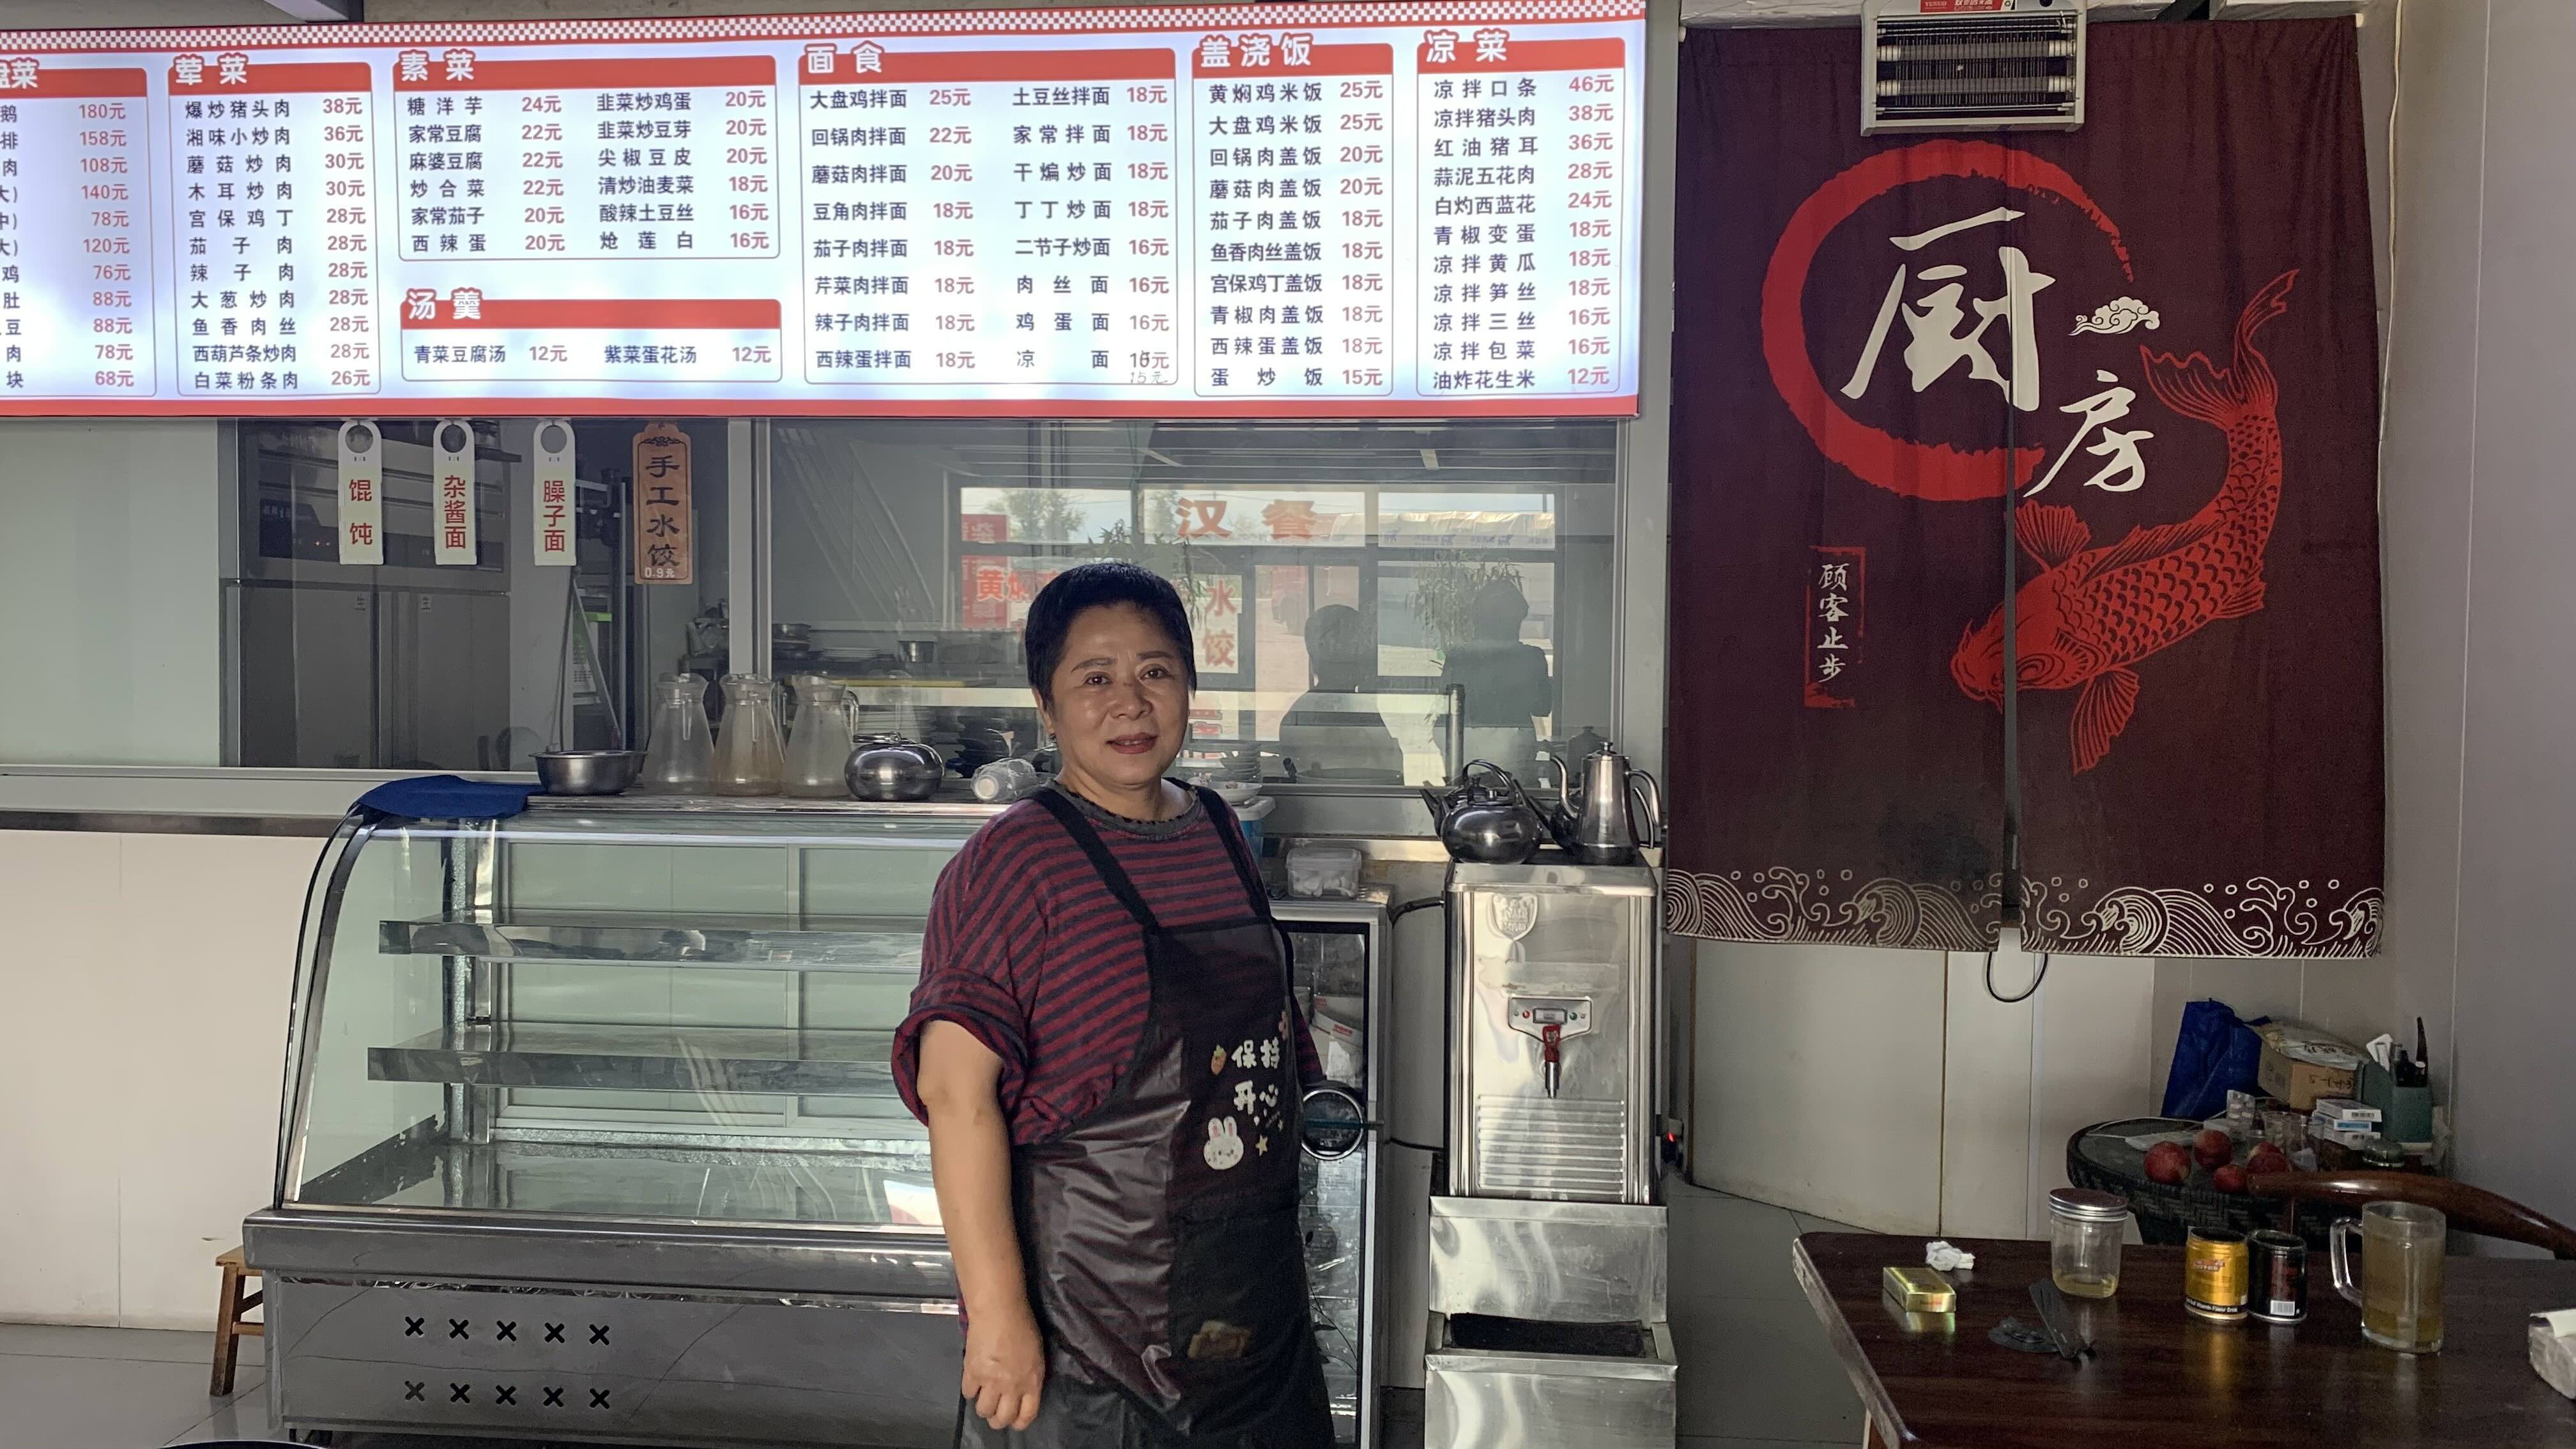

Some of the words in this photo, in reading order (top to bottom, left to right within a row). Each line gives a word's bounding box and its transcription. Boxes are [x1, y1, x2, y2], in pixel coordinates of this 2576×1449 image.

[1200, 35, 1312, 68] 盖浇饭
[1426, 32, 1508, 64] 凉菜
[401, 51, 475, 82] 素菜
[807, 45, 882, 74] 面食
[175, 55, 248, 86] 荤菜
[1013, 86, 1110, 105] 土豆丝拌面
[1127, 86, 1167, 103] 18元
[1209, 82, 1322, 103] 黄焖鸡米饭
[1340, 80, 1383, 98] 25元
[1434, 77, 1537, 99] 凉拌口条
[1569, 75, 1614, 93] 46元
[185, 99, 289, 119] 爆炒猪头肉
[323, 97, 362, 115] 38元
[407, 96, 482, 116] 糖洋芋
[523, 96, 562, 113] 24元
[597, 92, 691, 112] 韭菜炒鸡蛋
[726, 91, 766, 108] 20元
[810, 89, 907, 109] 大盘鸡拌面
[930, 88, 971, 106] 25元
[79, 103, 125, 119] 180元
[1434, 107, 1535, 128] 凉拌猪头肉
[1569, 103, 1613, 121] 38元
[409, 124, 482, 143] 家常豆腐
[522, 124, 562, 141] 22元
[598, 119, 691, 139] 韭菜炒豆芽
[726, 119, 767, 136] 20元
[1013, 124, 1111, 144] 家常拌面
[1128, 124, 1168, 142] 18元
[1209, 114, 1322, 135] 大盘鸡米饭
[1340, 113, 1383, 131] 25元
[80, 130, 126, 146] 158元
[187, 126, 289, 146] 湘味小炒肉
[325, 125, 364, 142] 36元
[812, 126, 907, 146] 回锅肉拌面
[930, 126, 971, 144] 22元
[1434, 136, 1538, 157] 红油猪耳
[1569, 133, 1613, 151] 36元
[81, 157, 127, 173] 108元
[187, 154, 291, 174] 蘑菇炒肉
[325, 153, 364, 169] 30元
[409, 151, 482, 171] 麻婆豆腐
[523, 151, 563, 169] 22元
[598, 147, 691, 167] 尖椒豆皮
[727, 147, 767, 165] 20元
[1211, 146, 1322, 167] 回锅肉盖饭
[1340, 145, 1383, 164] 20元
[811, 164, 907, 184] 蘑菇肉拌面
[931, 164, 972, 181] 20元
[1014, 162, 1112, 182] 干煸炒面
[1128, 162, 1169, 180] 18元
[1434, 165, 1534, 187] 蒜泥五花肉
[1568, 162, 1613, 180] 28元
[82, 184, 128, 200] 140元
[188, 181, 292, 201] 木耳炒肉
[326, 180, 365, 197] 30元
[410, 179, 484, 198] 炒合菜
[524, 179, 564, 196] 22元
[598, 175, 694, 195] 清炒油麦菜
[730, 175, 768, 193] 18元
[1209, 178, 1321, 199] 蘑菇肉盖饭
[1340, 178, 1383, 195] 20元
[599, 203, 694, 222] 酸辣土豆丝
[730, 203, 769, 221] 16元
[813, 202, 907, 220] 豆角肉拌面
[934, 202, 973, 219] 18元
[1015, 200, 1111, 219] 丁丁炒面
[1129, 201, 1169, 218] 18元
[1436, 194, 1535, 215] 白灼西蓝花
[1568, 190, 1612, 209] 24元
[92, 211, 128, 227] 78元
[189, 209, 293, 228] 宫保鸡丁
[327, 208, 366, 224] 28元
[411, 206, 484, 226] 家常茄子
[525, 207, 564, 224] 20元
[1210, 210, 1321, 230] 茄子肉盖饭
[1342, 210, 1383, 227] 18元
[600, 231, 693, 249] 炝莲白
[731, 232, 769, 249] 16元
[1434, 224, 1535, 245] 青椒变蛋
[1570, 220, 1611, 238] 18元
[84, 238, 130, 254] 120元
[189, 236, 292, 255] 茄子肉
[328, 234, 367, 252] 28元
[411, 234, 486, 252] 西辣蛋
[526, 234, 565, 251] 20元
[813, 239, 908, 257] 茄子肉拌面
[935, 240, 974, 257] 18元
[1015, 238, 1110, 257] 二节子炒面
[1130, 238, 1169, 256] 16元
[1211, 242, 1321, 262] 鱼香肉丝盖饭
[1342, 241, 1383, 259] 18元
[1434, 252, 1535, 274] 凉拌黄瓜
[1569, 249, 1611, 267] 18元
[94, 264, 130, 280] 76元
[190, 263, 293, 282] 辣子肉
[328, 262, 367, 279] 28元
[815, 276, 908, 295] 芹菜肉拌面
[935, 277, 974, 294] 18元
[1017, 275, 1108, 294] 肉丝面
[1130, 277, 1169, 294] 16元
[1211, 273, 1322, 293] 宫保鸡丁盖饭
[1342, 273, 1383, 291] 18元
[1434, 282, 1536, 303] 凉拌笋丝
[1569, 278, 1610, 296] 18元
[191, 290, 294, 309] 大葱炒肉
[329, 289, 368, 305] 28元
[408, 291, 481, 320] 汤羹
[815, 313, 910, 332] 辣子肉拌面
[936, 314, 974, 331] 18元
[1016, 312, 1109, 331] 鸡蛋面
[1130, 314, 1169, 331] 16元
[1210, 305, 1323, 325] 青椒肉盖饭
[1343, 305, 1383, 323] 18元
[1434, 311, 1535, 332] 凉拌三丝
[1569, 307, 1610, 325] 16元
[192, 318, 296, 335] 鱼香肉丝
[330, 316, 369, 332] 28元
[192, 344, 296, 362] 西葫芦条炒肉
[331, 343, 369, 359] 28元
[414, 345, 505, 364] 青菜豆腐汤
[530, 346, 567, 362] 12元
[604, 345, 696, 364] 紫菜蛋花汤
[733, 346, 771, 363] 12元
[1211, 336, 1322, 355] 西辣蛋盖饭
[1343, 337, 1383, 354] 18元
[1434, 340, 1535, 361] 凉拌包菜
[1569, 337, 1610, 355] 16元
[1841, 206, 2154, 498] 厨房
[816, 350, 911, 369] 西辣蛋拌面
[937, 351, 975, 368] 18元
[1017, 349, 1109, 368] 凉面
[96, 371, 134, 387] 68元
[195, 371, 297, 390] 白菜粉条肉
[332, 370, 370, 387] 26元
[1211, 368, 1322, 386] 蛋炒饭
[1343, 369, 1382, 386] 15元
[1434, 369, 1535, 390] 油炸花生米
[1568, 367, 1609, 385] 12元
[349, 479, 372, 546] 馄饨
[444, 475, 466, 549] 杂酱面
[543, 480, 566, 552] 臊子面
[645, 455, 680, 567] 手工水饺
[1176, 498, 1318, 540] 汉餐
[645, 567, 675, 578] 0.9元
[1203, 579, 1236, 668] 水饺
[1817, 563, 1850, 683] 顾客止步
[1231, 1036, 1280, 1069] 保持
[1233, 1080, 1279, 1115] 开心
